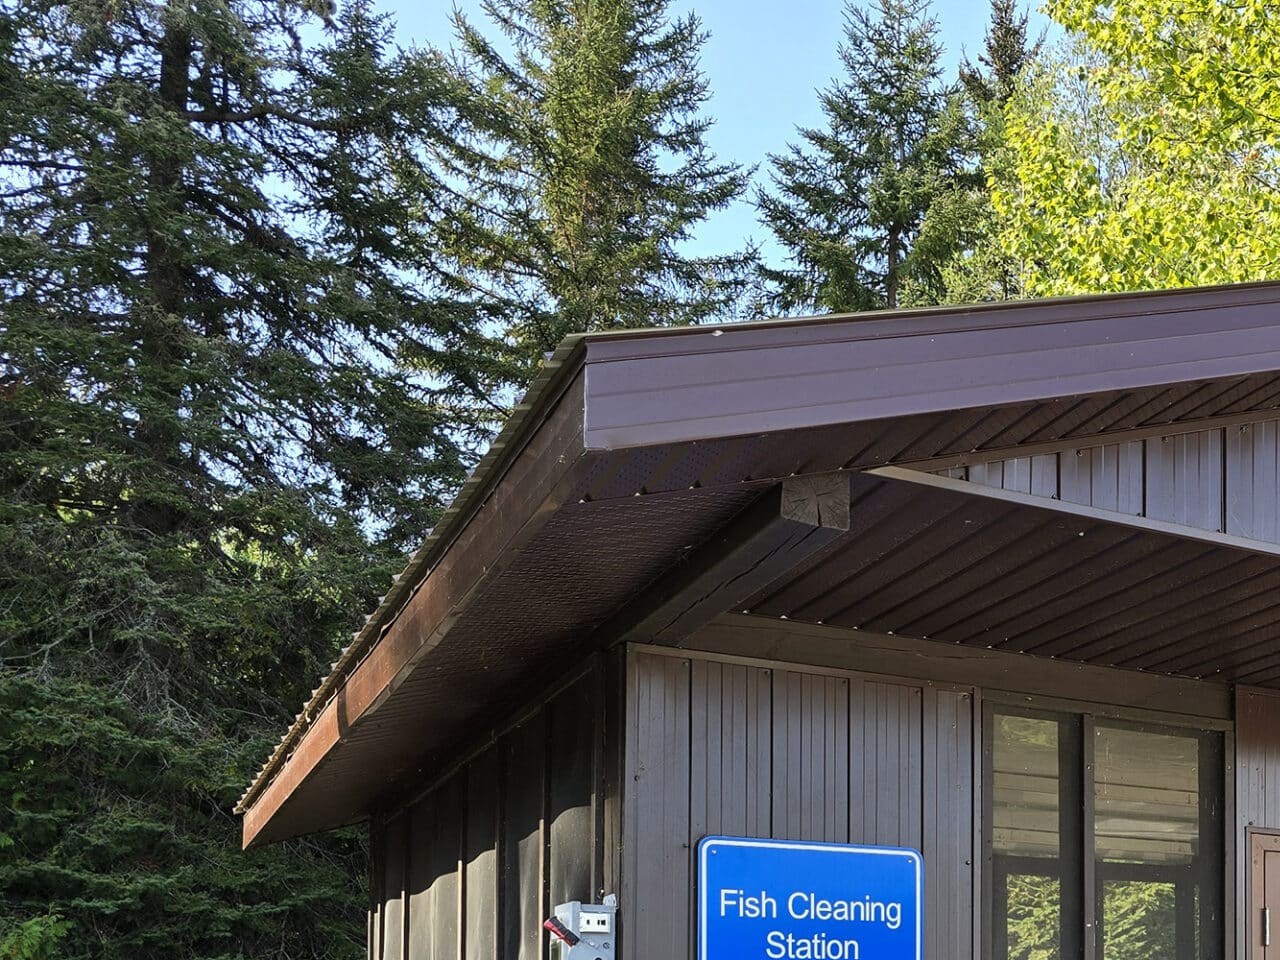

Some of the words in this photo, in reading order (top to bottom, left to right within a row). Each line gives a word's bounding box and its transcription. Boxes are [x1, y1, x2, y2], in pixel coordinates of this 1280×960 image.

[719, 889, 777, 918] Fish
[787, 892, 902, 930] Cleaning
[766, 931, 859, 960] Station
